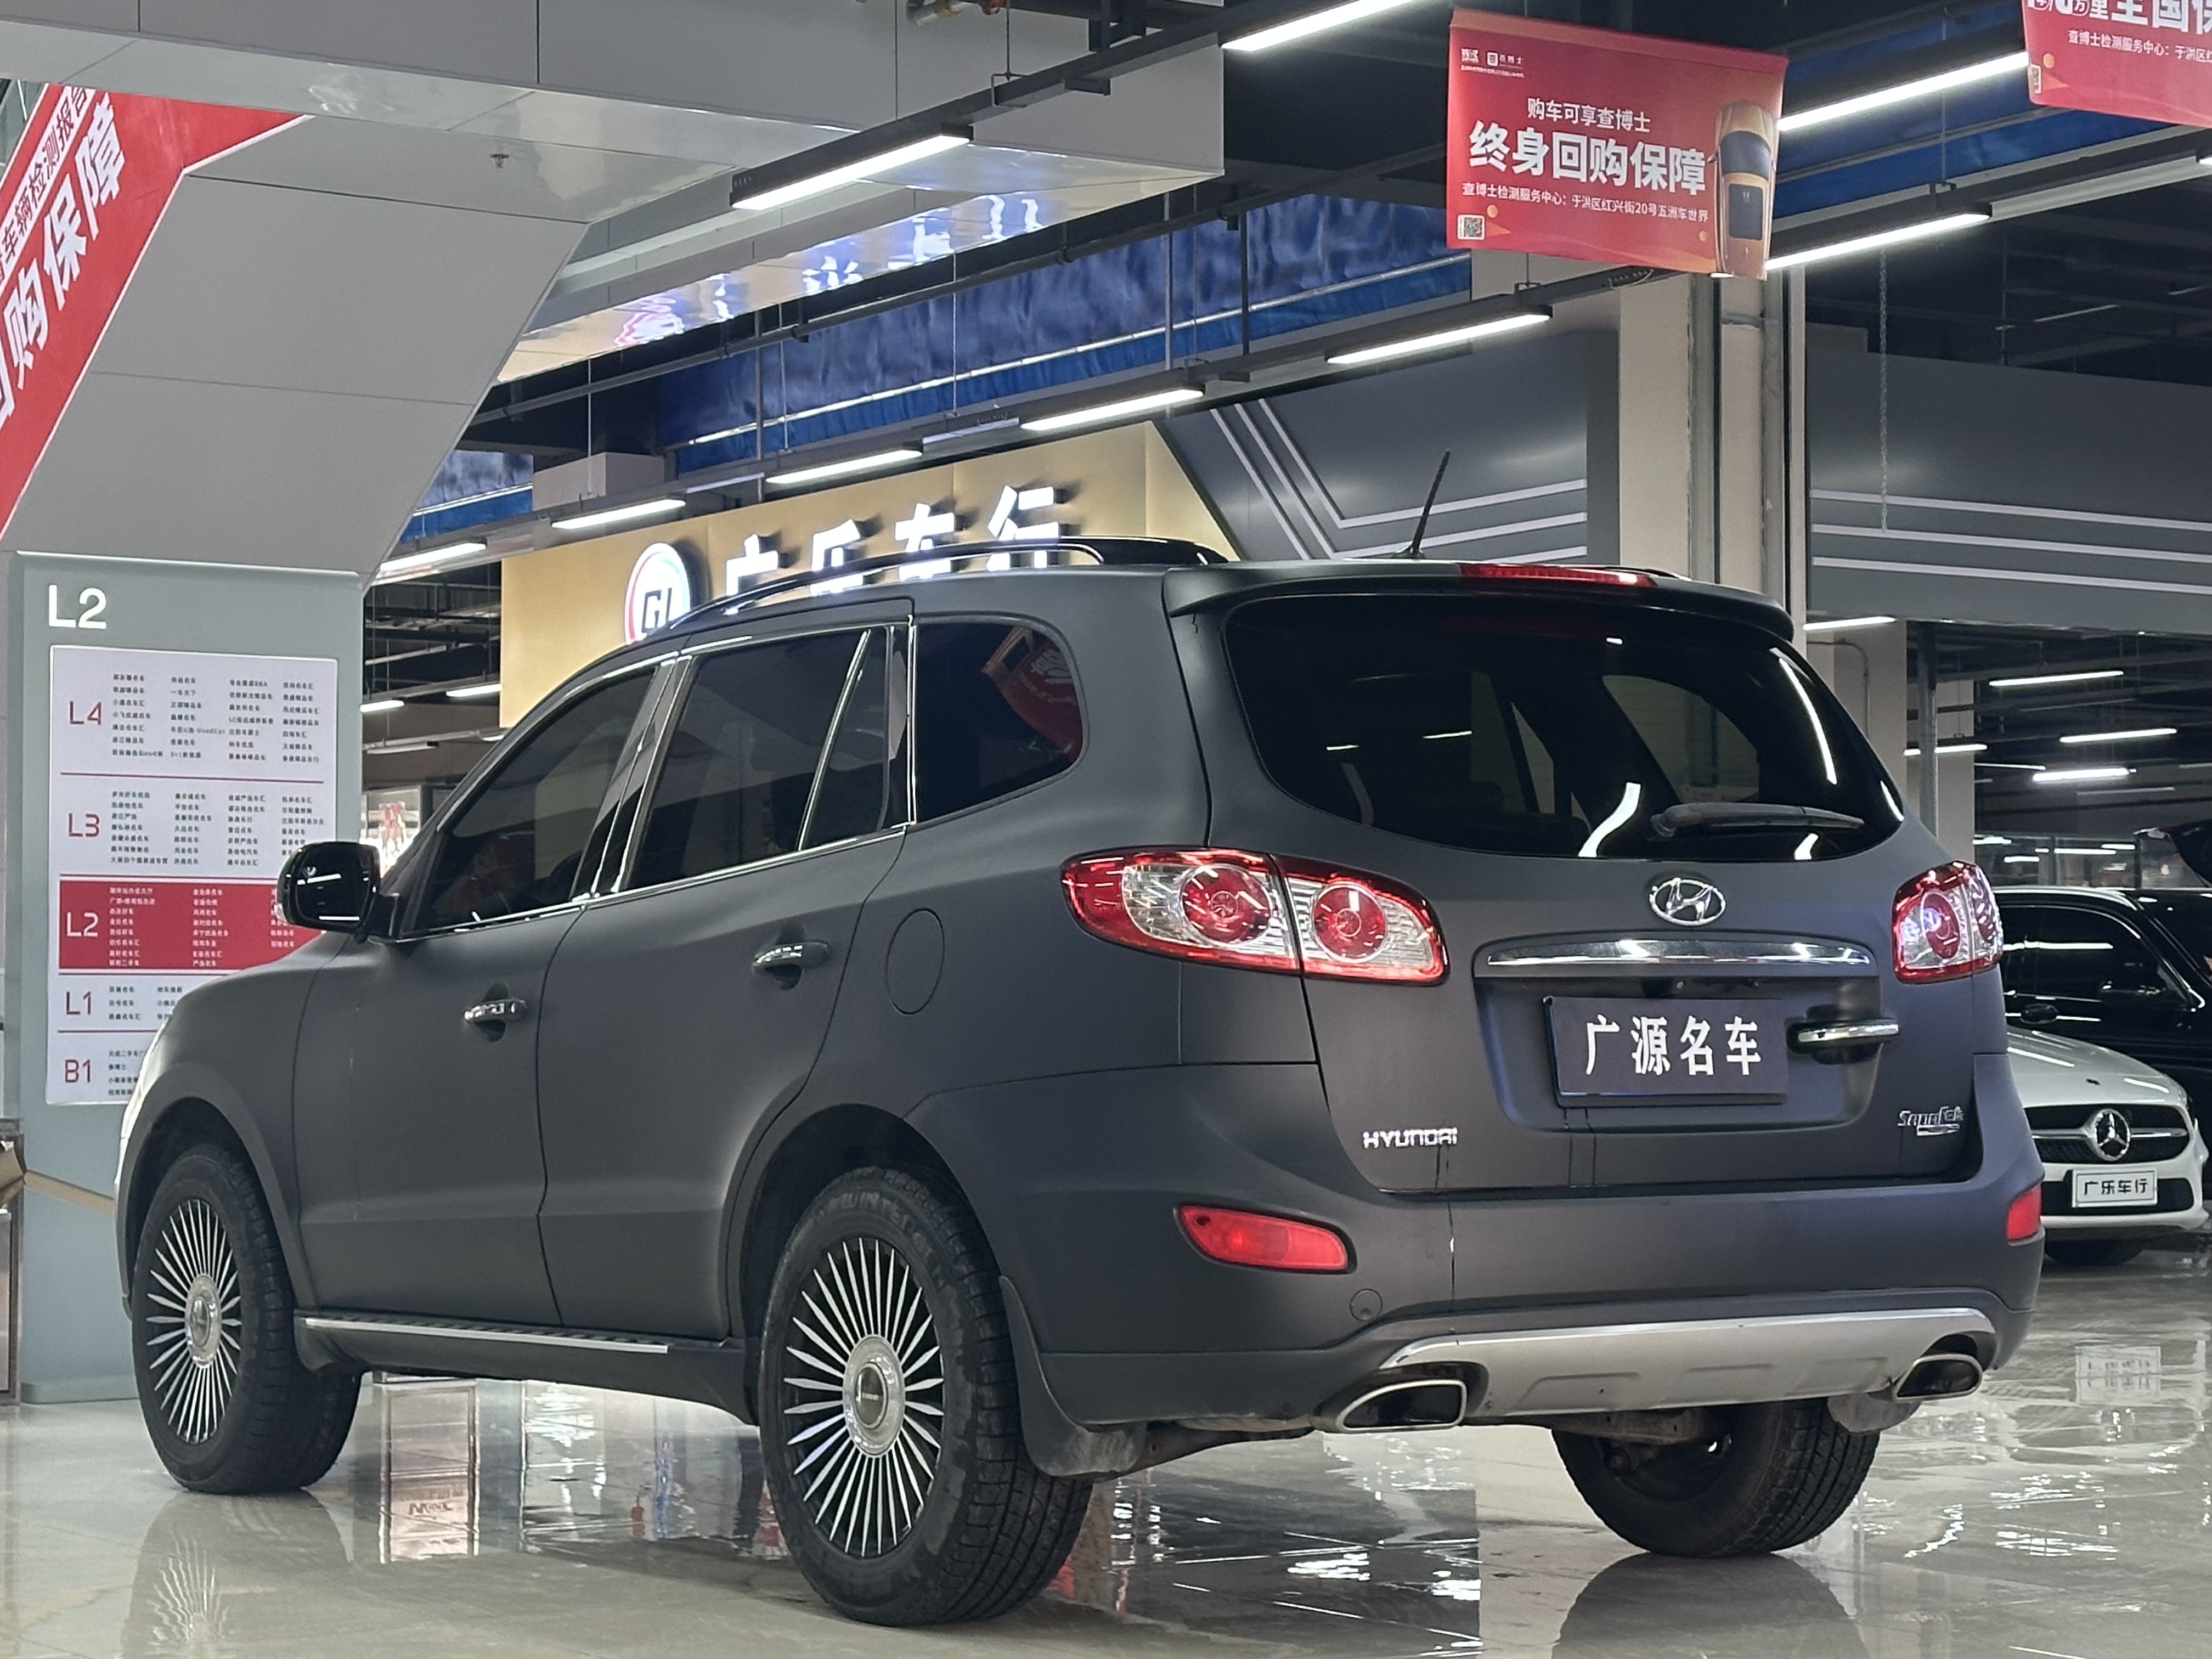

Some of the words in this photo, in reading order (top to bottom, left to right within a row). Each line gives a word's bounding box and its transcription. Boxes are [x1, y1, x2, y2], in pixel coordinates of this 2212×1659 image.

[1527, 97, 1651, 133] 购车可享查博士
[1469, 120, 1706, 195] 终身回购保障
[49, 584, 107, 629] L2
[70, 701, 102, 725] L4
[68, 812, 100, 837] L3
[66, 911, 99, 936] L2
[66, 991, 92, 1015] L1
[1585, 1014, 1762, 1076] 广源名车
[65, 1059, 91, 1084] B1
[1363, 1127, 1458, 1149] HYUNDAI
[2084, 1178, 2148, 1195] 广乐车行
